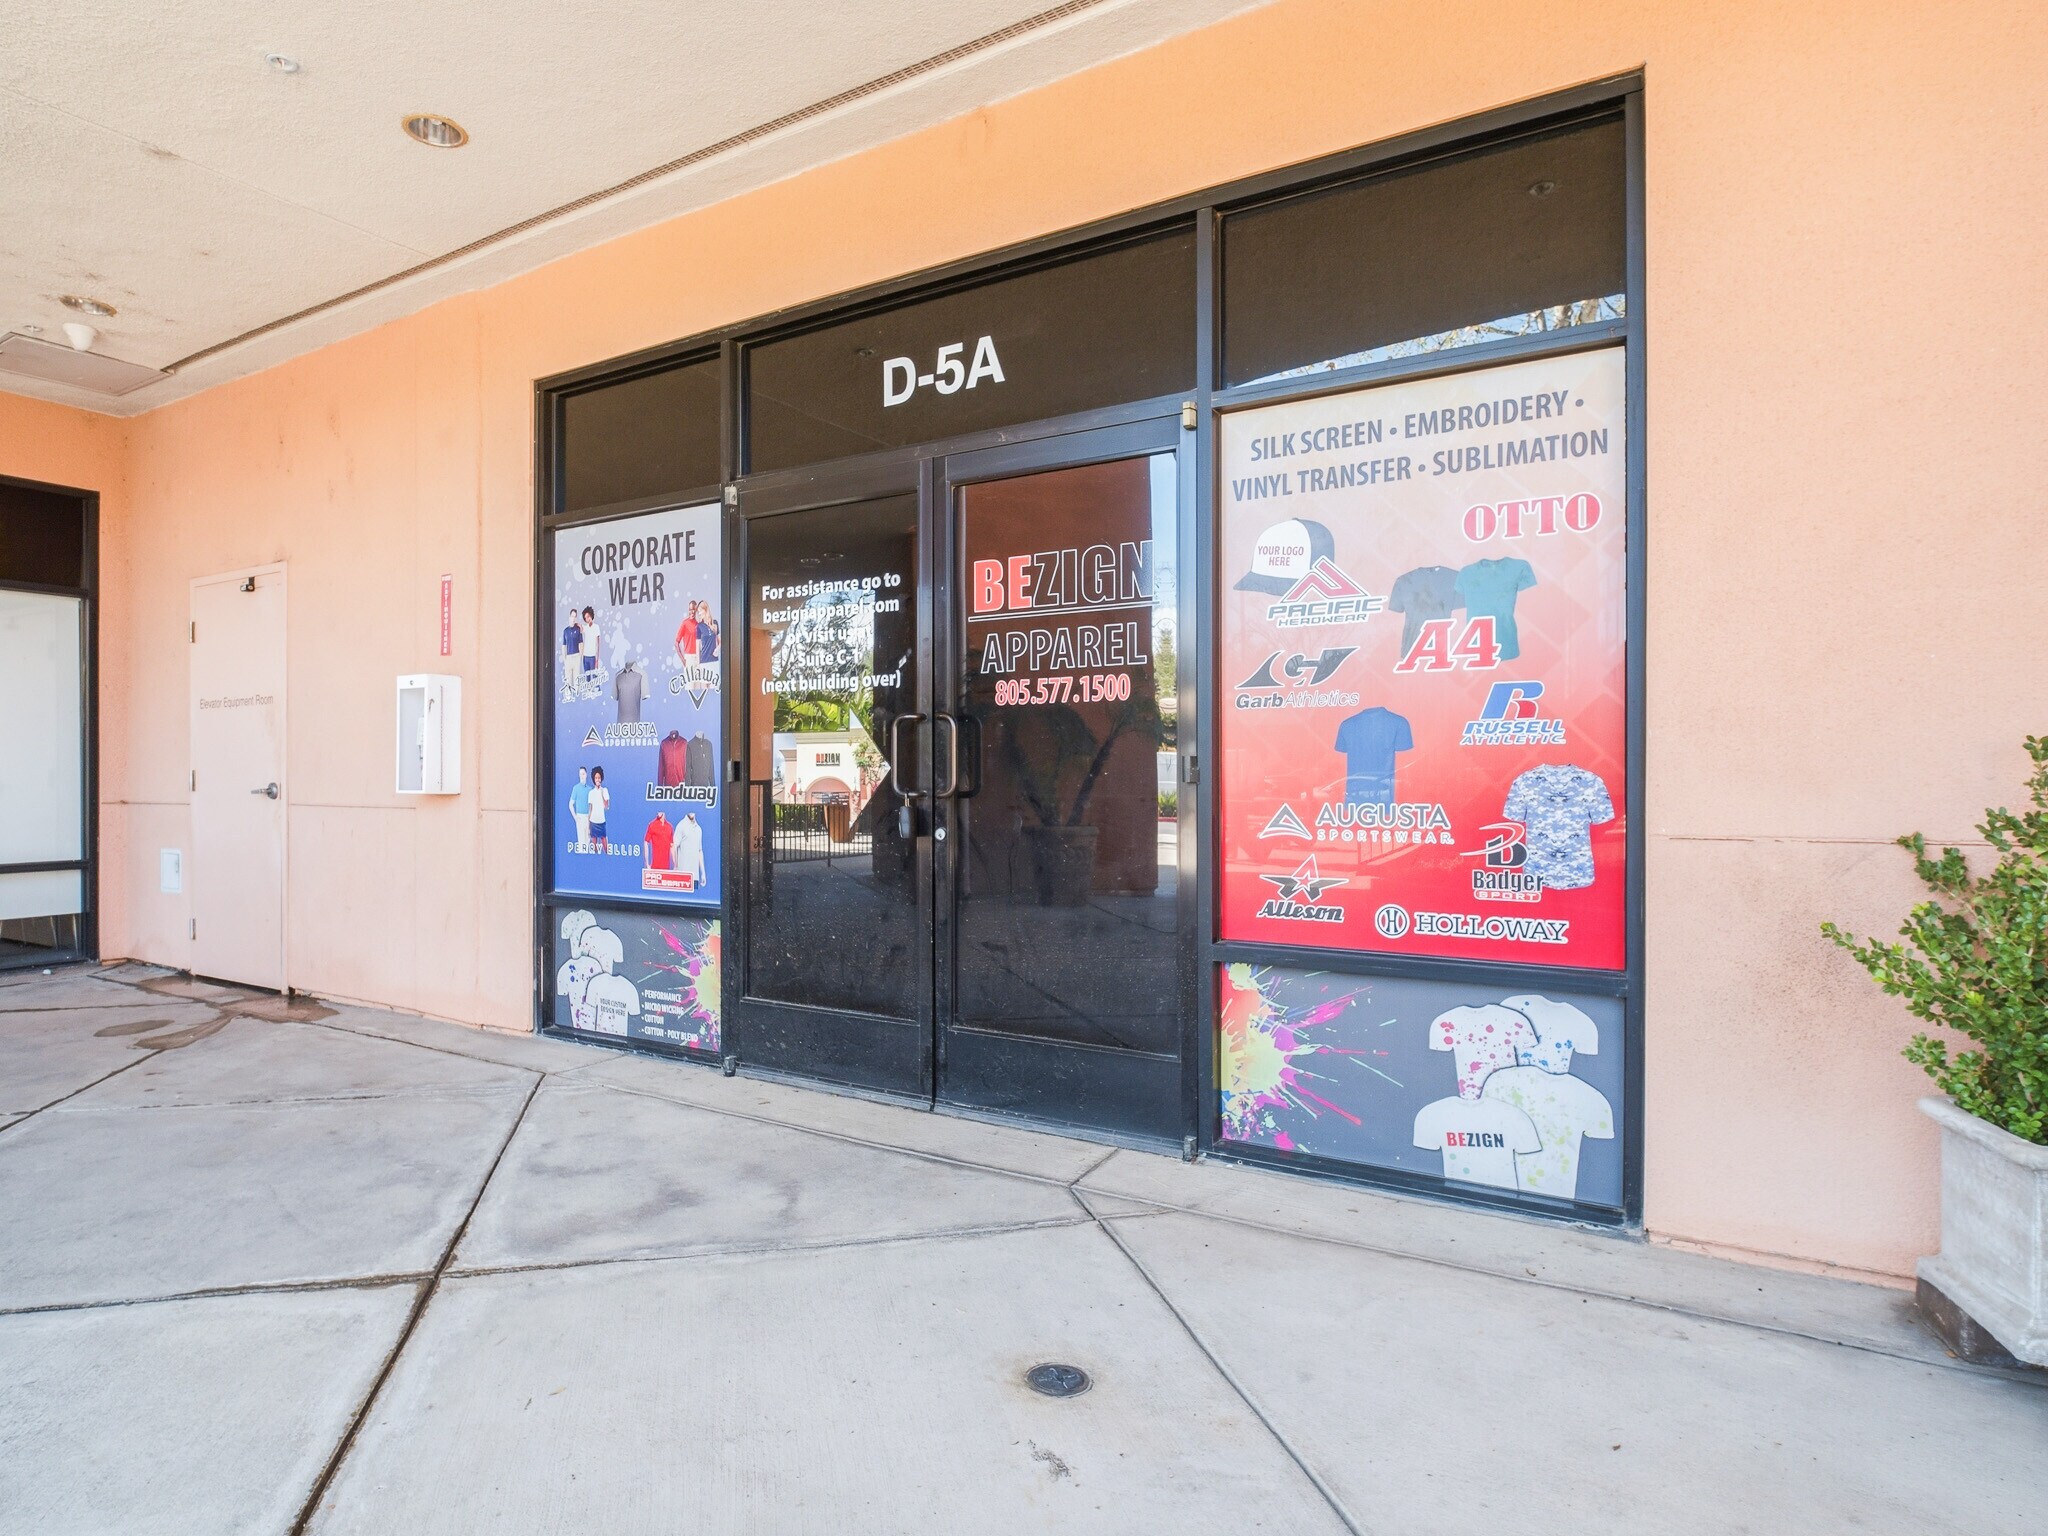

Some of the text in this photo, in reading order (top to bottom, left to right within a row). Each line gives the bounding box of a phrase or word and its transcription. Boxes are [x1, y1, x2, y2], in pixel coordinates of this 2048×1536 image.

[883, 335, 1006, 408] D-5A
[1250, 390, 1569, 462] SILK SCREEN EMBROIDERY
[1232, 428, 1608, 502] VINYL TRANSFER SUBLIMATION
[1463, 492, 1602, 543] OTTO
[581, 529, 696, 576] CORPORATE
[1257, 545, 1305, 556] YOUR LOGO
[1268, 556, 1291, 567] HERE
[762, 572, 901, 601] For assistance go to
[973, 539, 1156, 613] BEZIGN
[608, 572, 665, 607] WEAR
[1268, 597, 1383, 620] PACIFIC
[1278, 614, 1367, 627] HEADWEAR
[980, 622, 1148, 674] APPAREL
[1394, 616, 1502, 672] A4
[797, 648, 834, 667] Suite
[761, 669, 901, 696] (next building over)
[995, 673, 1131, 707] 805.577.1500
[255, 694, 274, 706] Room
[605, 722, 658, 738] AUGUSTA
[1463, 719, 1565, 735] RUSSELL
[1460, 734, 1564, 745] ATHLETIC
[646, 782, 718, 808] Landway
[1316, 803, 1452, 829] AUGUSTA
[1317, 829, 1450, 844] SPORTSWEAR
[567, 841, 641, 857] PERRY ELLIS
[1472, 869, 1544, 892] Badger
[1477, 890, 1538, 902] SPORT
[1257, 899, 1344, 923] Alleson
[1415, 912, 1569, 943] HOLLOWAY
[644, 989, 682, 1002] PERFORMANCE
[616, 1008, 626, 1017] HERE
[644, 1014, 664, 1024] COTTON
[644, 1026, 664, 1037] COTTON
[667, 1030, 681, 1040] POLY
[1446, 1132, 1504, 1148] BEZIGN
